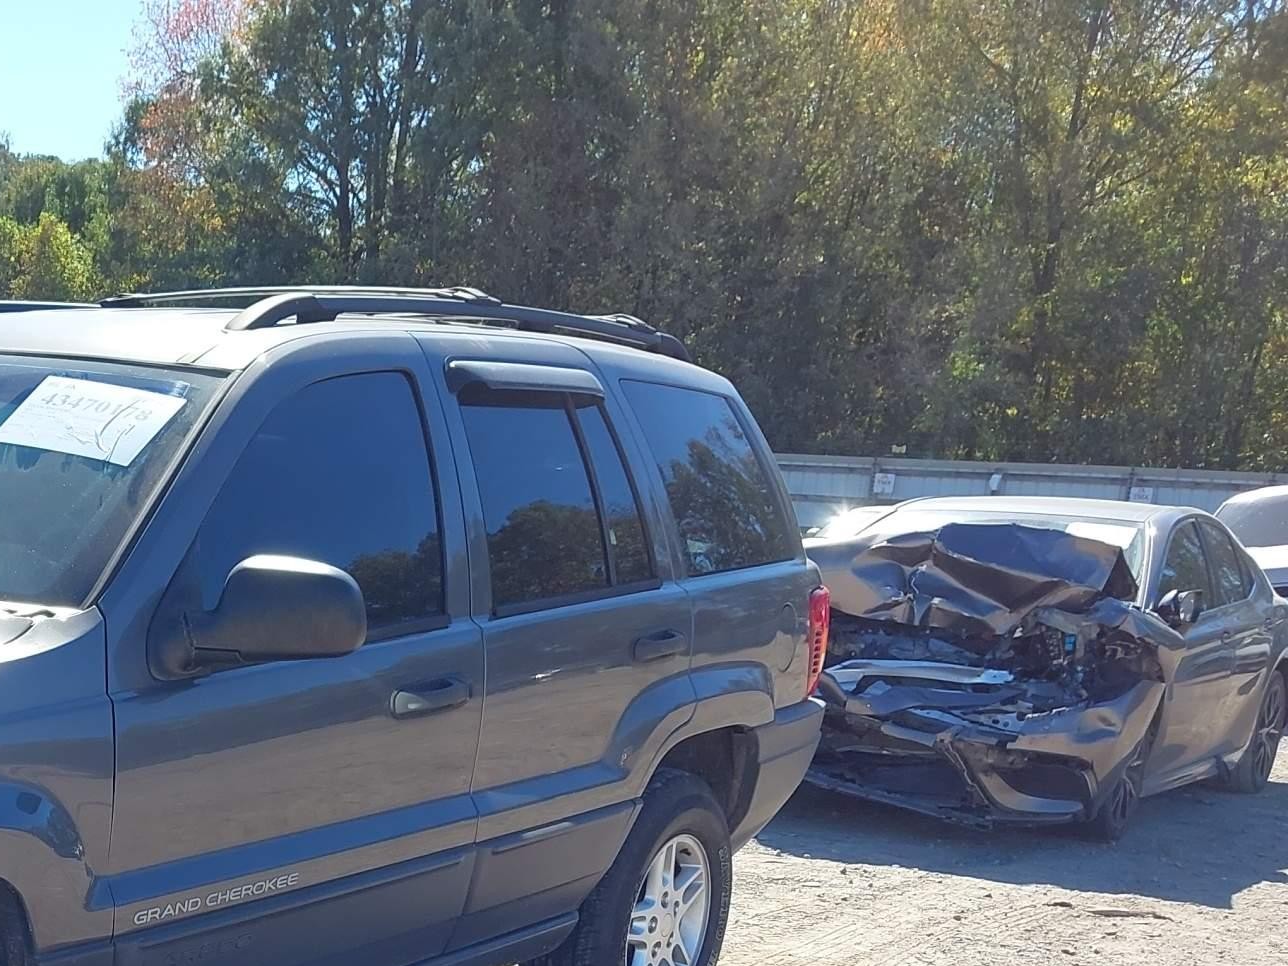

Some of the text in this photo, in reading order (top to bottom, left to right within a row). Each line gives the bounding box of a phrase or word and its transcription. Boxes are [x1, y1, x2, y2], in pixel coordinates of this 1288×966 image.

[41, 392, 153, 421] 43470178
[133, 872, 299, 925] GRAND CHEROKEE
